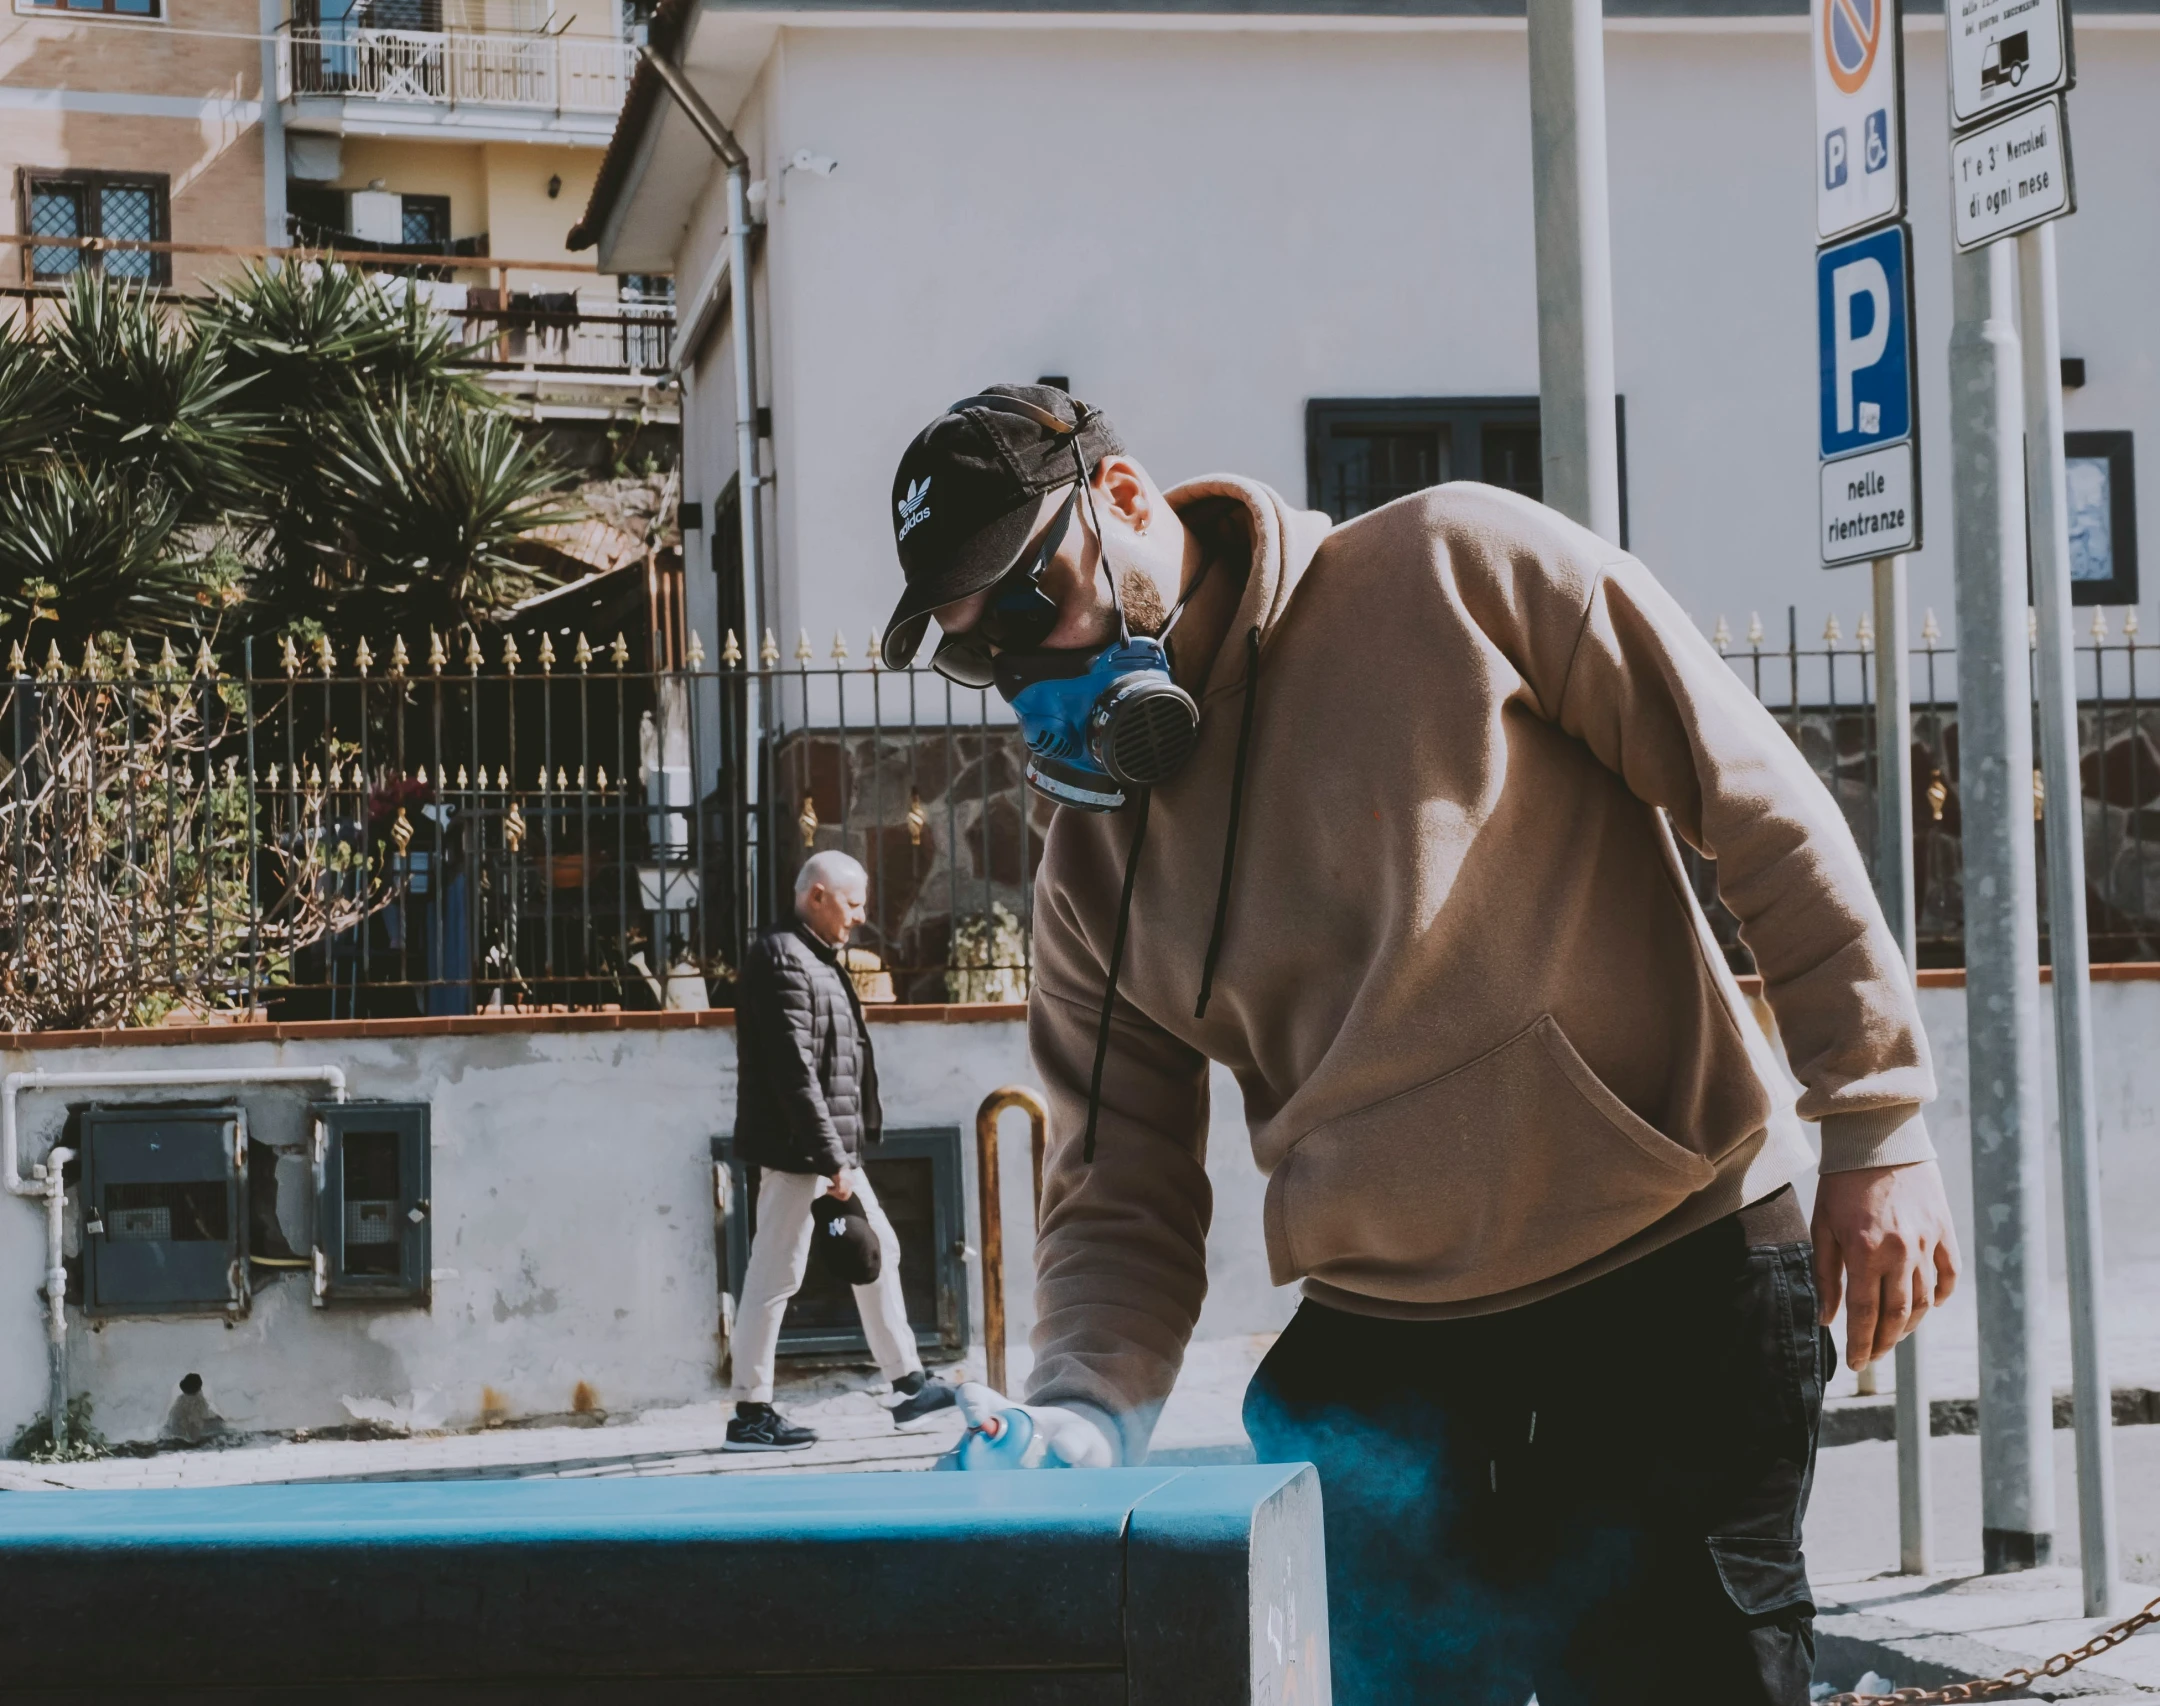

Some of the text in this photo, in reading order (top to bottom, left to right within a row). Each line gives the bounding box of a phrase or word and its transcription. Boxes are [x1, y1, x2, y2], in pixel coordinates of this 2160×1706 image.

[1976, 159, 1983, 176] e
[1969, 170, 2049, 218] di ogni mese
[1833, 257, 1891, 433] P
[1848, 470, 1885, 500] nelle
[899, 507, 931, 541] adidas
[1828, 508, 1905, 543] rientranze
